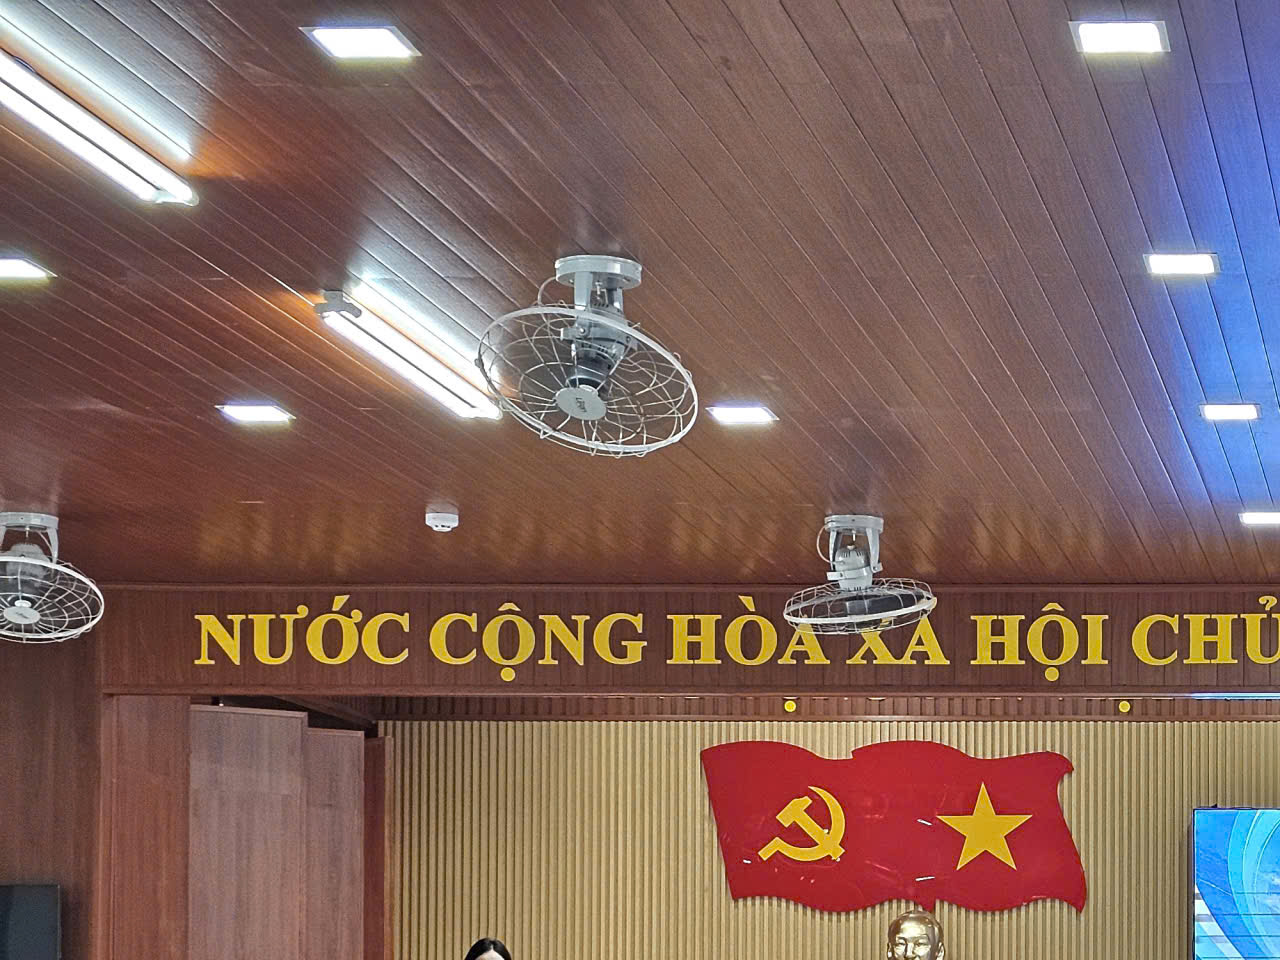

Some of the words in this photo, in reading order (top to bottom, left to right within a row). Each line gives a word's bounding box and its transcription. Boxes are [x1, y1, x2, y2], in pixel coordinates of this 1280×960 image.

[194, 595, 409, 665] NƯỚC
[428, 603, 645, 682] CỘNG
[668, 595, 831, 666] HÒA
[971, 602, 1108, 681] HỘI
